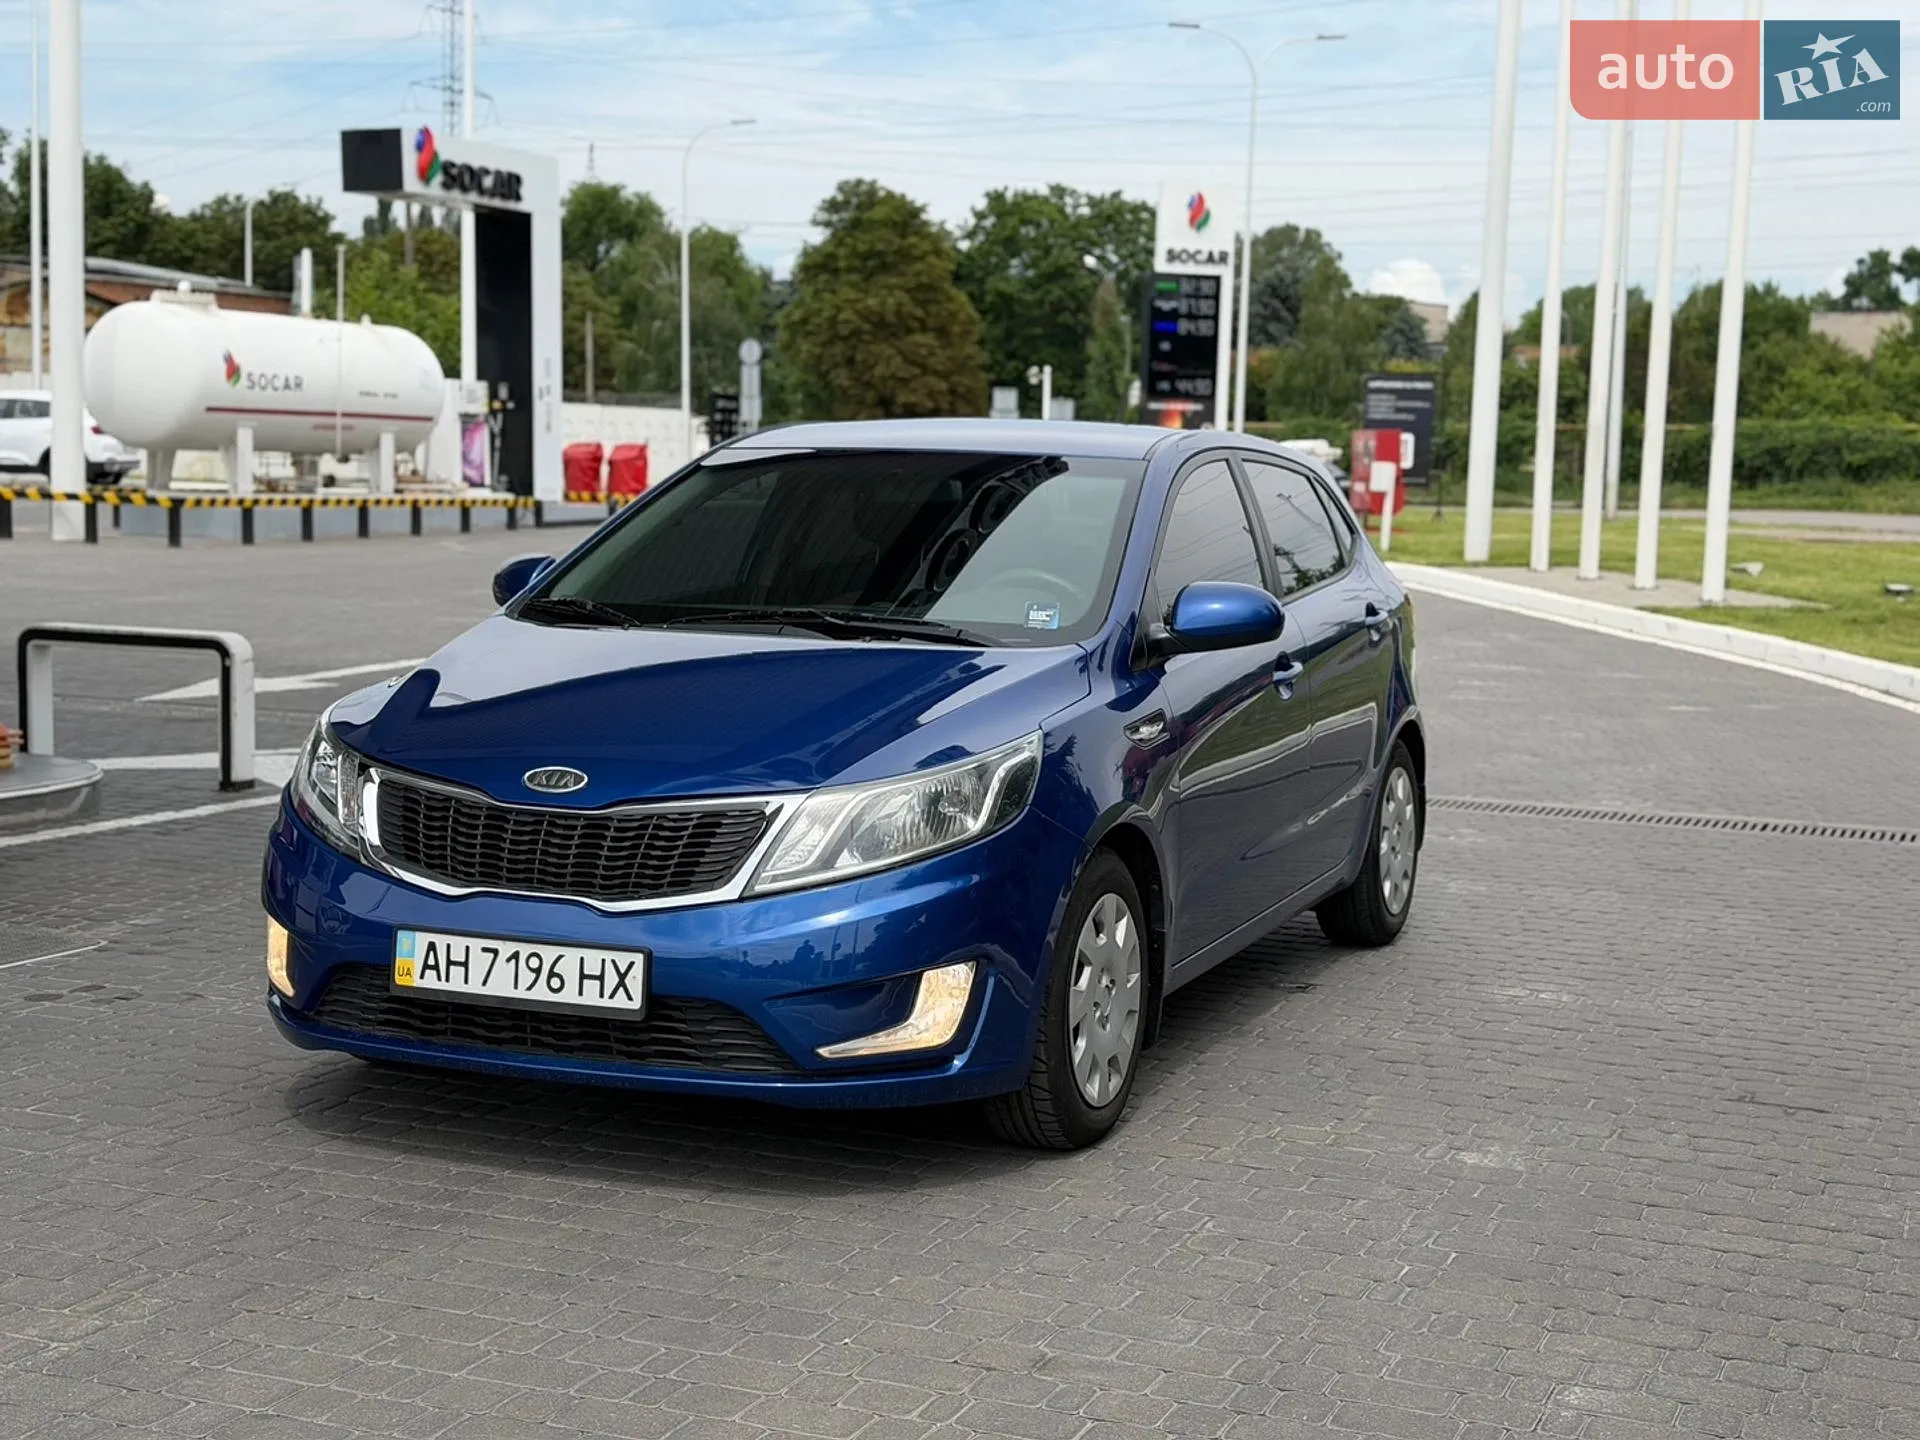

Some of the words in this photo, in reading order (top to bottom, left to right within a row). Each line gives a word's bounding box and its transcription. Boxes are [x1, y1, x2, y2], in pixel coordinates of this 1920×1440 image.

[441, 159, 523, 202] SOCAR
[1165, 247, 1230, 266] SOCAR
[246, 372, 304, 392] SOCAR
[533, 769, 575, 788] KIA
[397, 967, 413, 979] UA
[419, 940, 471, 986] AH
[480, 946, 567, 995] 7196
[577, 956, 637, 1002] HX
